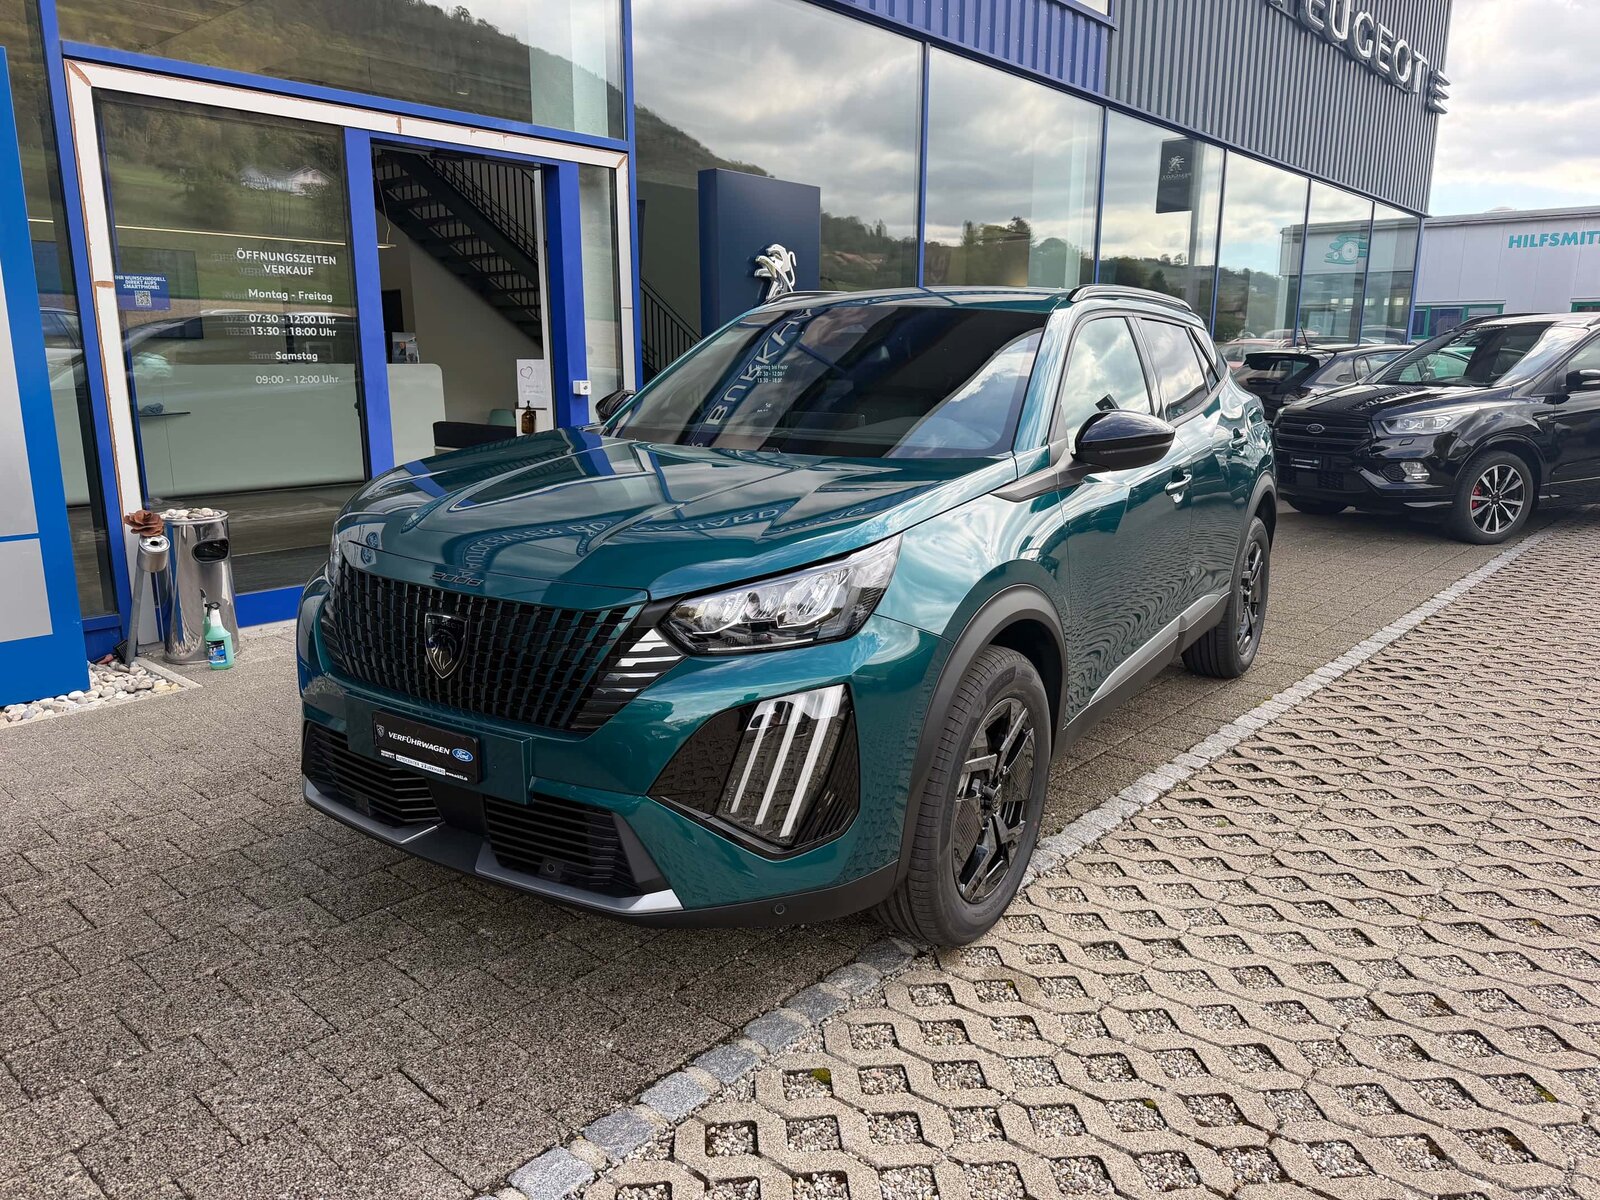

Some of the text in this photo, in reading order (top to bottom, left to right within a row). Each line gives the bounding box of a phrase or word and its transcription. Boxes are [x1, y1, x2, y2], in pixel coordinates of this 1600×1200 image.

[1266, 0, 1429, 95] EUGEOT
[236, 247, 337, 265] ÖFFNUNGSZEITEN
[263, 263, 315, 276] VERKAUF
[248, 288, 289, 301] Montag
[298, 290, 333, 303] Freitag
[248, 313, 279, 324] 07:30
[288, 315, 317, 324] 12:00
[318, 315, 336, 325] Uhr
[251, 326, 280, 336] 13:30
[290, 327, 317, 336] 18:00
[319, 327, 337, 337] Uhr
[275, 351, 319, 362] Samstag
[255, 375, 284, 385] 09:00
[294, 375, 320, 385] 12:00
[321, 374, 339, 384] Uhr
[388, 731, 451, 755] VERFÜHRWAGEN
